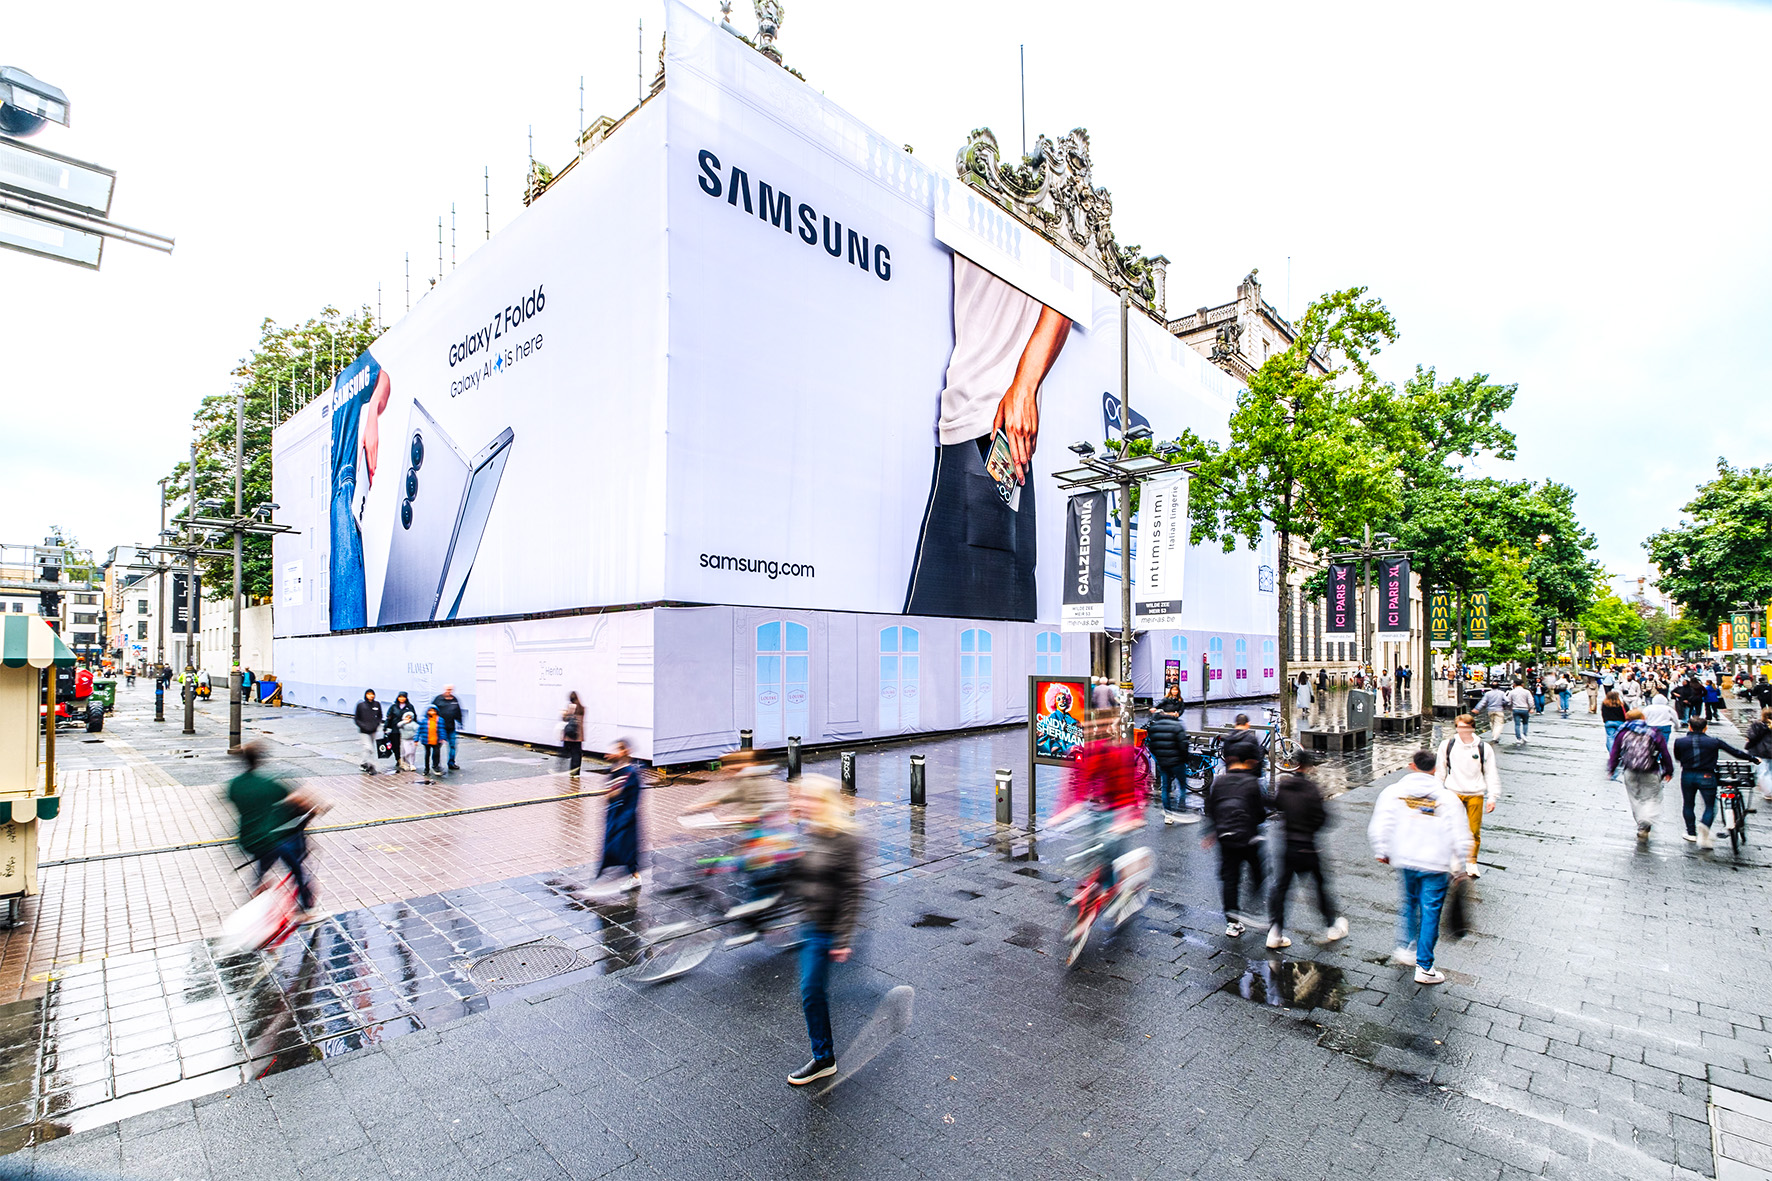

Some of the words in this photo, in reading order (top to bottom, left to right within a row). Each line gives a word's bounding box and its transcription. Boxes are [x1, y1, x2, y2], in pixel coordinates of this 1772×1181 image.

[698, 149, 891, 281] SAMSUNG
[449, 323, 492, 367] Galaxy
[494, 312, 501, 340] Z
[505, 284, 545, 333] Fold6
[450, 369, 481, 398] Galaxy
[483, 359, 492, 380] AI
[504, 349, 513, 368] is
[516, 333, 543, 361] here
[333, 365, 370, 411] SAMSUNG
[1170, 486, 1179, 520] lingerie
[1078, 498, 1093, 596] CALZEDONIA
[1168, 521, 1176, 550] Italian
[699, 553, 815, 580] samsung.com
[1336, 568, 1347, 580] XL
[1388, 565, 1400, 577] XL
[1335, 584, 1346, 611] PARIS
[1388, 581, 1400, 609] PARIS
[1335, 614, 1345, 627] ICI
[1388, 612, 1399, 626] ICI
[1036, 713, 1066, 731] CINDY
[1036, 722, 1085, 748] SHERMAN
